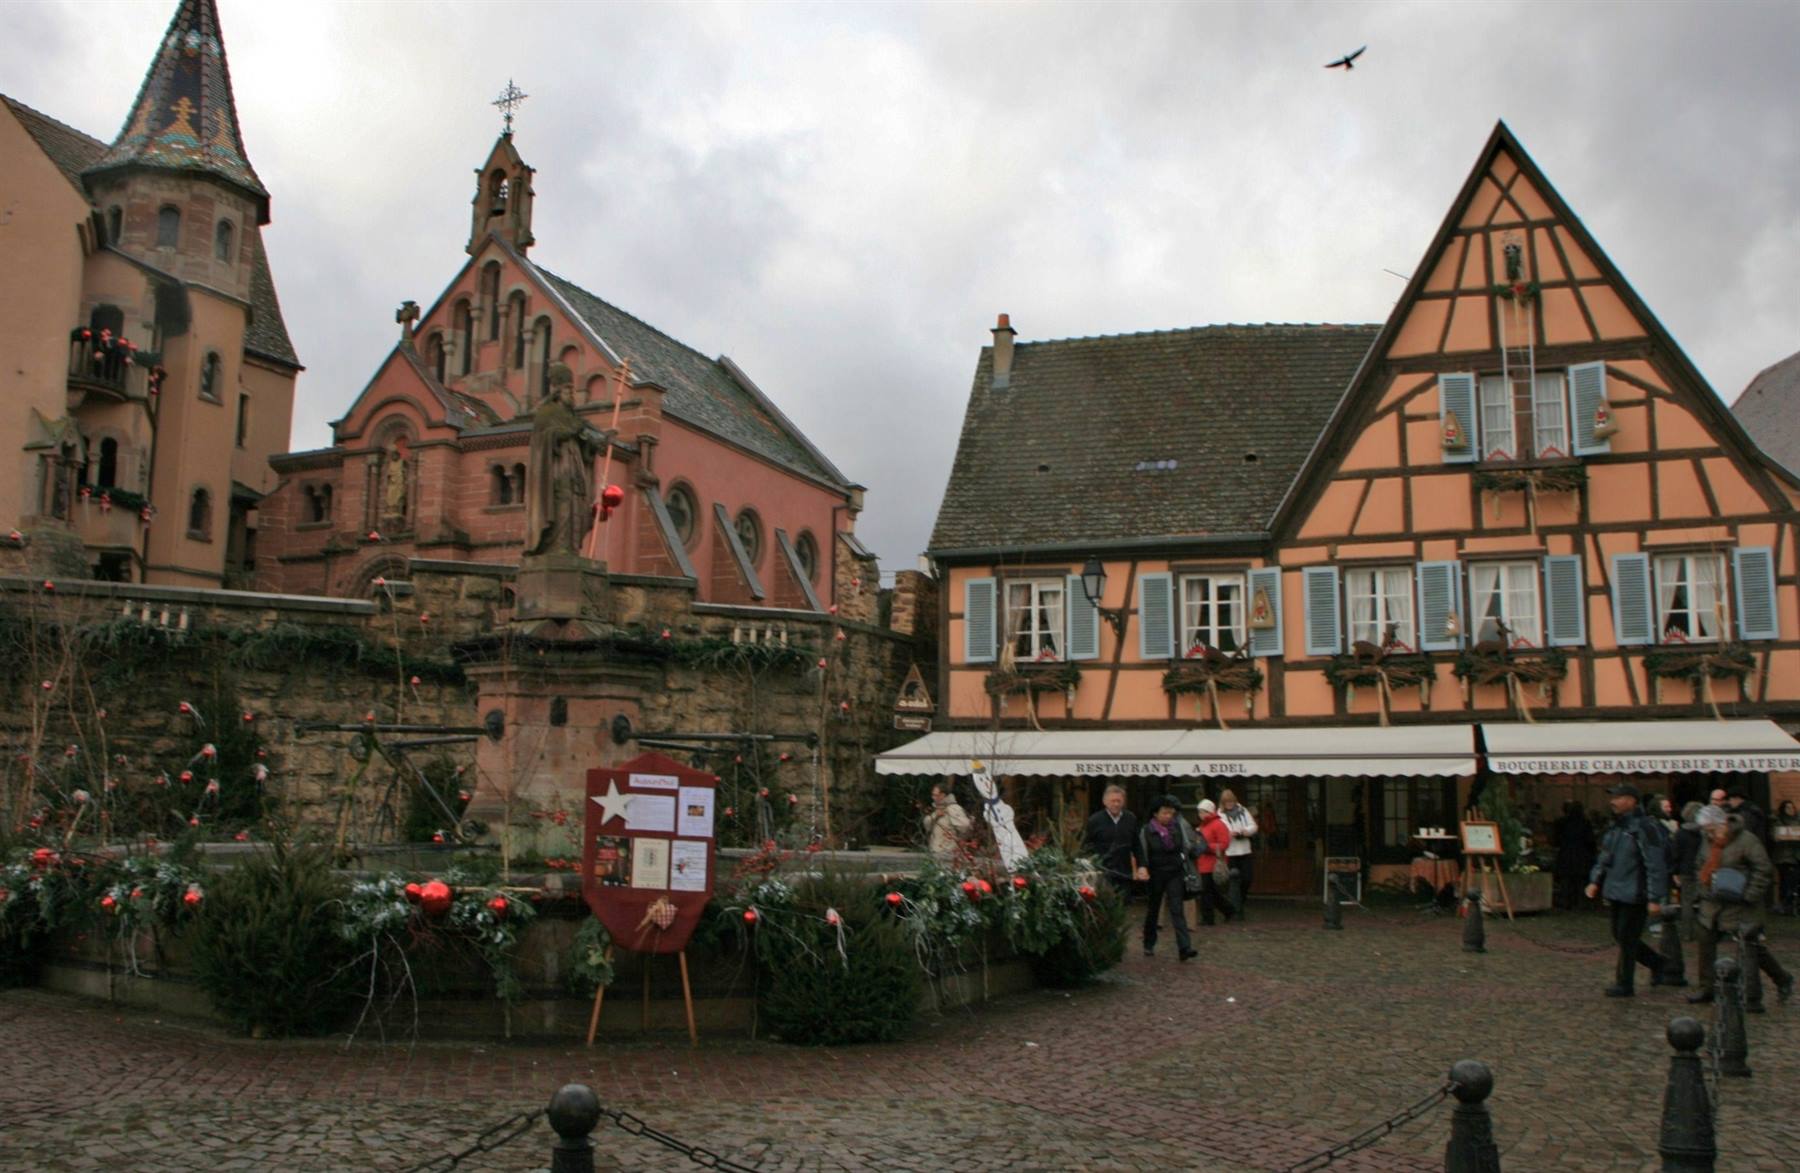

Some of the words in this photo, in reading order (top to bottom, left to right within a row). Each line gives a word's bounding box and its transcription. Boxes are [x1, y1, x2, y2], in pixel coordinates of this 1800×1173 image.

[1076, 763, 1170, 774] RESTAURANT
[1192, 763, 1206, 774] A.
[1210, 763, 1247, 774] EDEL
[1497, 760, 1588, 771] BOUCHERIE
[1592, 758, 1710, 770] CHARCUTERIE
[1715, 757, 1800, 769] TRAITEUR
